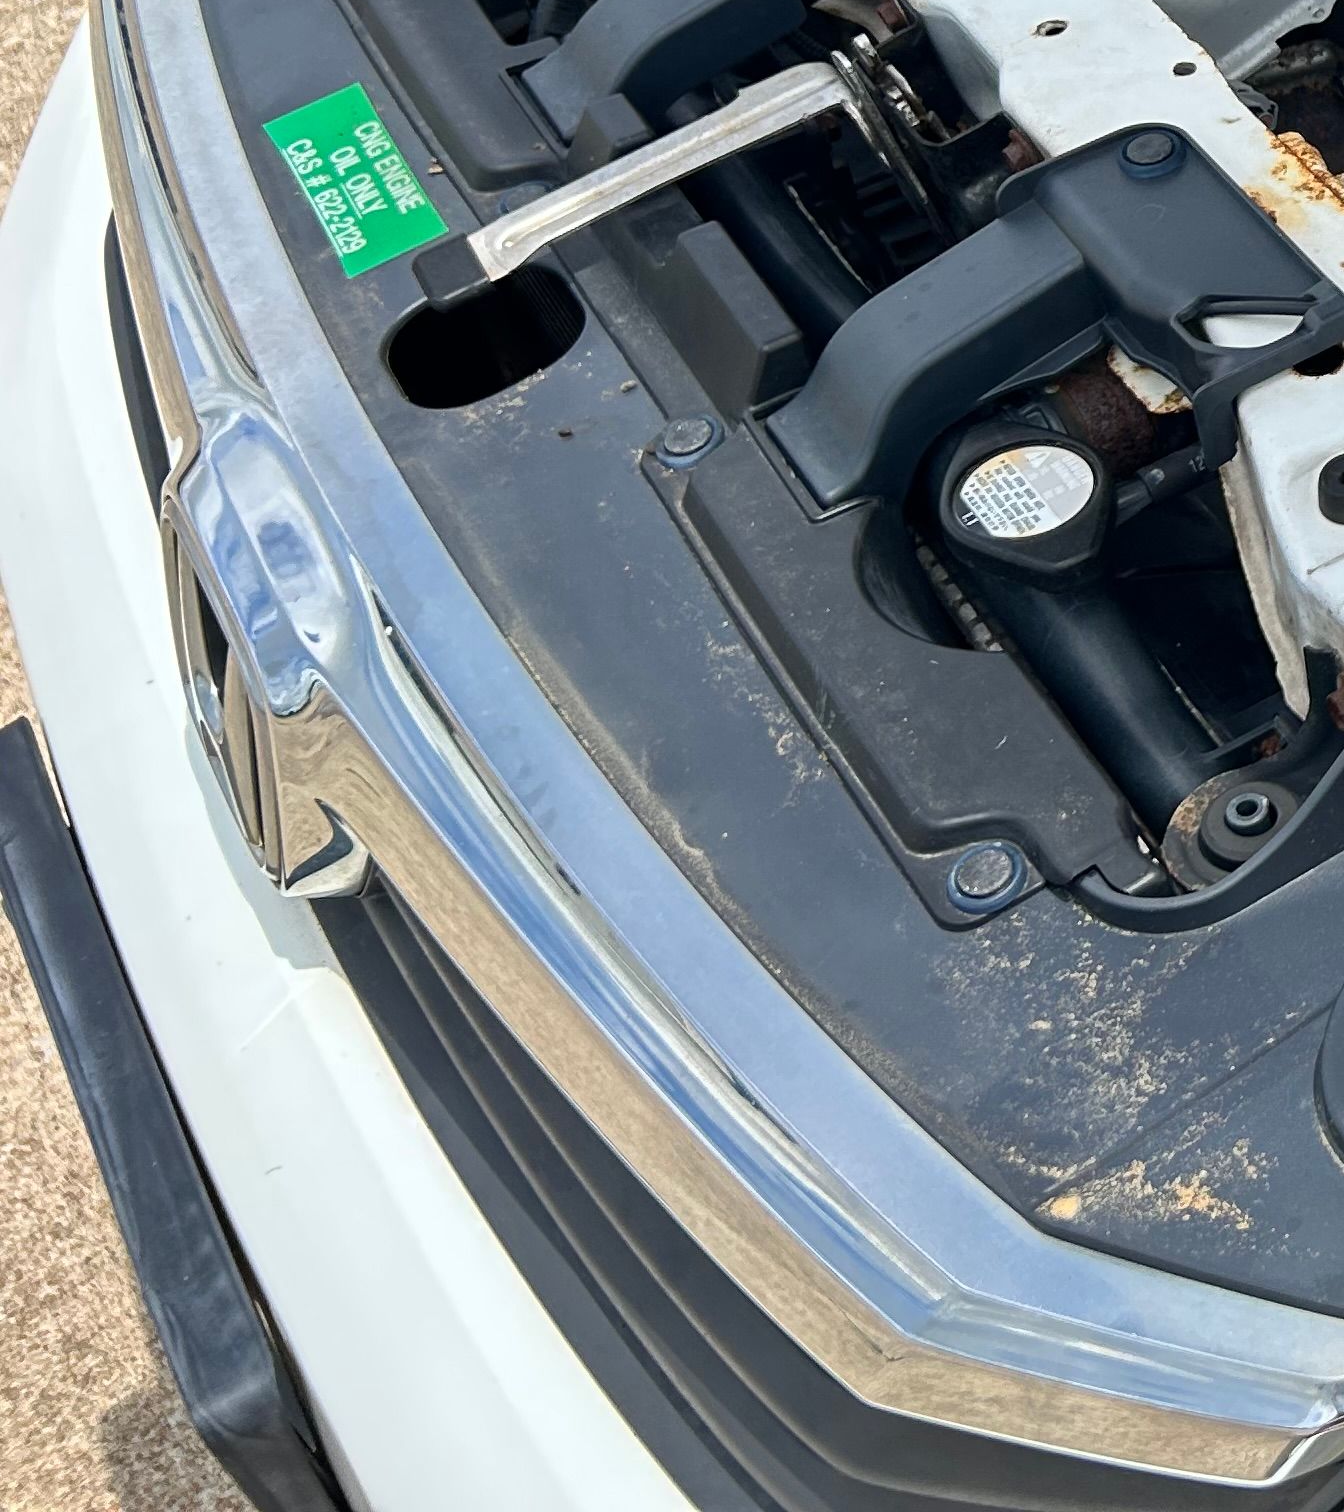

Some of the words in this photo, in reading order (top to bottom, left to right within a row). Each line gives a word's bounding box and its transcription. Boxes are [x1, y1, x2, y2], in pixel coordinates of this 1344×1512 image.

[286, 138, 323, 175] C&S
[329, 145, 361, 177] OIL
[353, 120, 391, 159] CNG
[373, 156, 426, 215] ENGINE
[305, 174, 332, 188] #
[344, 172, 388, 216] ONLY
[314, 188, 368, 255] 622-2129
